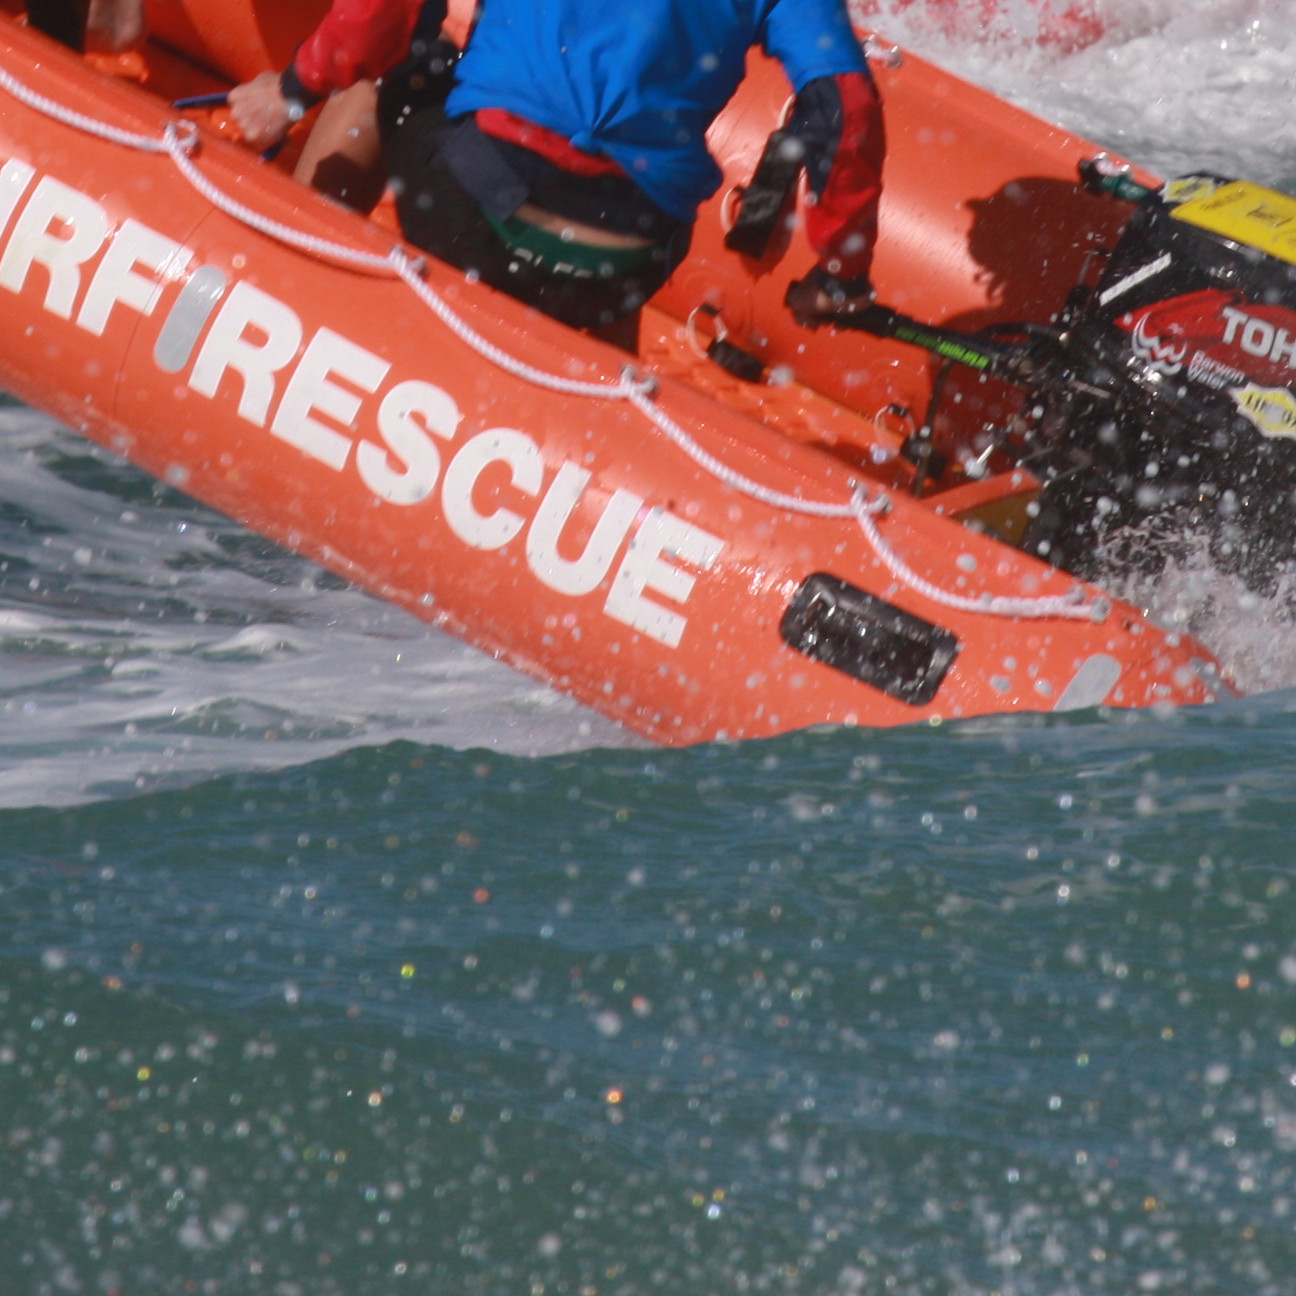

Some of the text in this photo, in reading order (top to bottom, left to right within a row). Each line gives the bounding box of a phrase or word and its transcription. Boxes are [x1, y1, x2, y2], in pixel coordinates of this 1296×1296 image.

[1186, 364, 1229, 390] Water
[1190, 350, 1245, 382] Barwon
[187, 280, 725, 649] RESCUE
